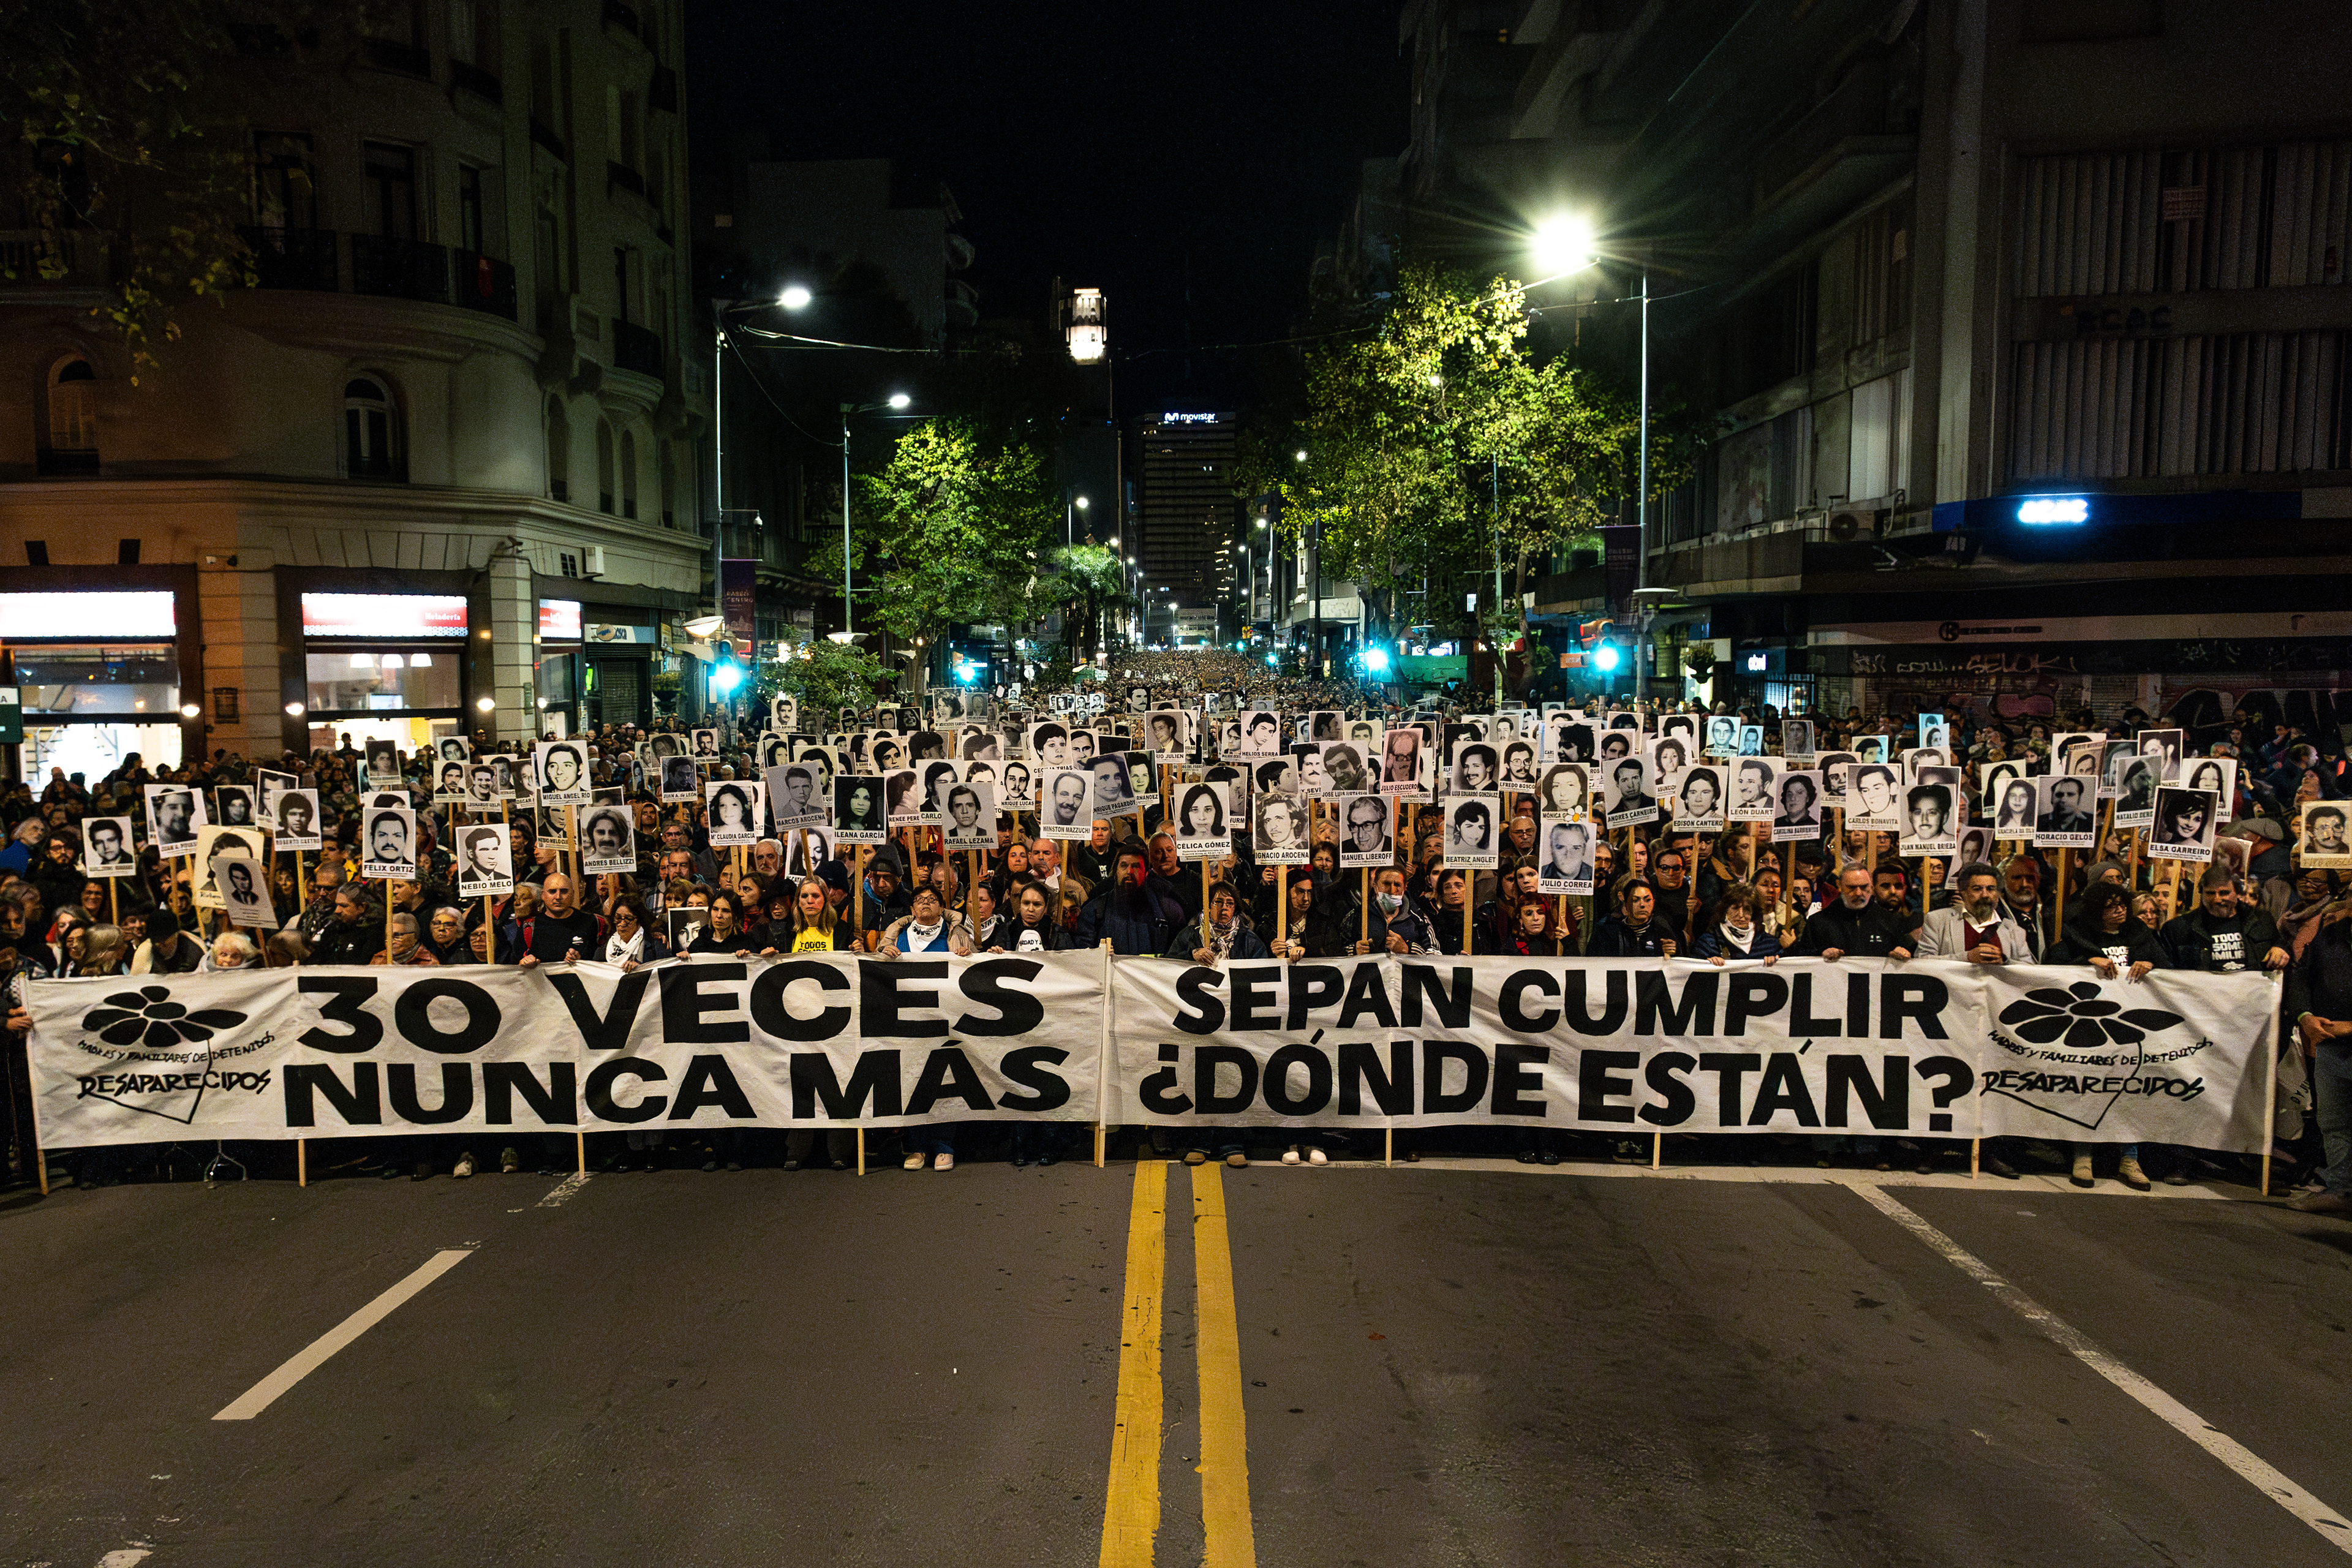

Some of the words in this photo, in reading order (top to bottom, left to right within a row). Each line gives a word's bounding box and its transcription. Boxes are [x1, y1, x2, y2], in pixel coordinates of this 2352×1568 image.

[800, 814, 826, 823] AROCENA
[1112, 799, 1136, 809] PAGARDOY
[1607, 813, 1629, 822] ANDRES
[1630, 807, 1657, 818] CARNEIRO
[461, 882, 488, 891] NEBIO
[799, 941, 827, 949] TODOS
[2212, 932, 2242, 943] TODO
[2212, 941, 2245, 952] SOMO
[298, 976, 502, 1055] 30
[545, 959, 1044, 1050] VECES
[1172, 963, 1474, 1036] SEPAN
[1498, 969, 1950, 1039] CUMPLIR
[78, 1039, 116, 1060] MADRES
[116, 1052, 125, 1060] Y
[126, 1050, 192, 1063] FAMILIARES
[192, 1053, 208, 1063] DE
[212, 1030, 275, 1060] DETENIDOS
[1987, 1029, 2027, 1057] MADRES
[2038, 1050, 2118, 1066] FAMILIARES
[2120, 1054, 2139, 1065] DE
[2143, 1036, 2214, 1065] DETENIDOS
[76, 1069, 271, 1100] DESAPARECIDOS
[284, 1054, 757, 1127] NUNCA
[791, 1040, 1071, 1120] MÁS
[1139, 1028, 1550, 1117] ¿DÓNDE
[1578, 1038, 1975, 1133] ESTÁN?
[1980, 1069, 2206, 1101] DESAPARECIDOS
